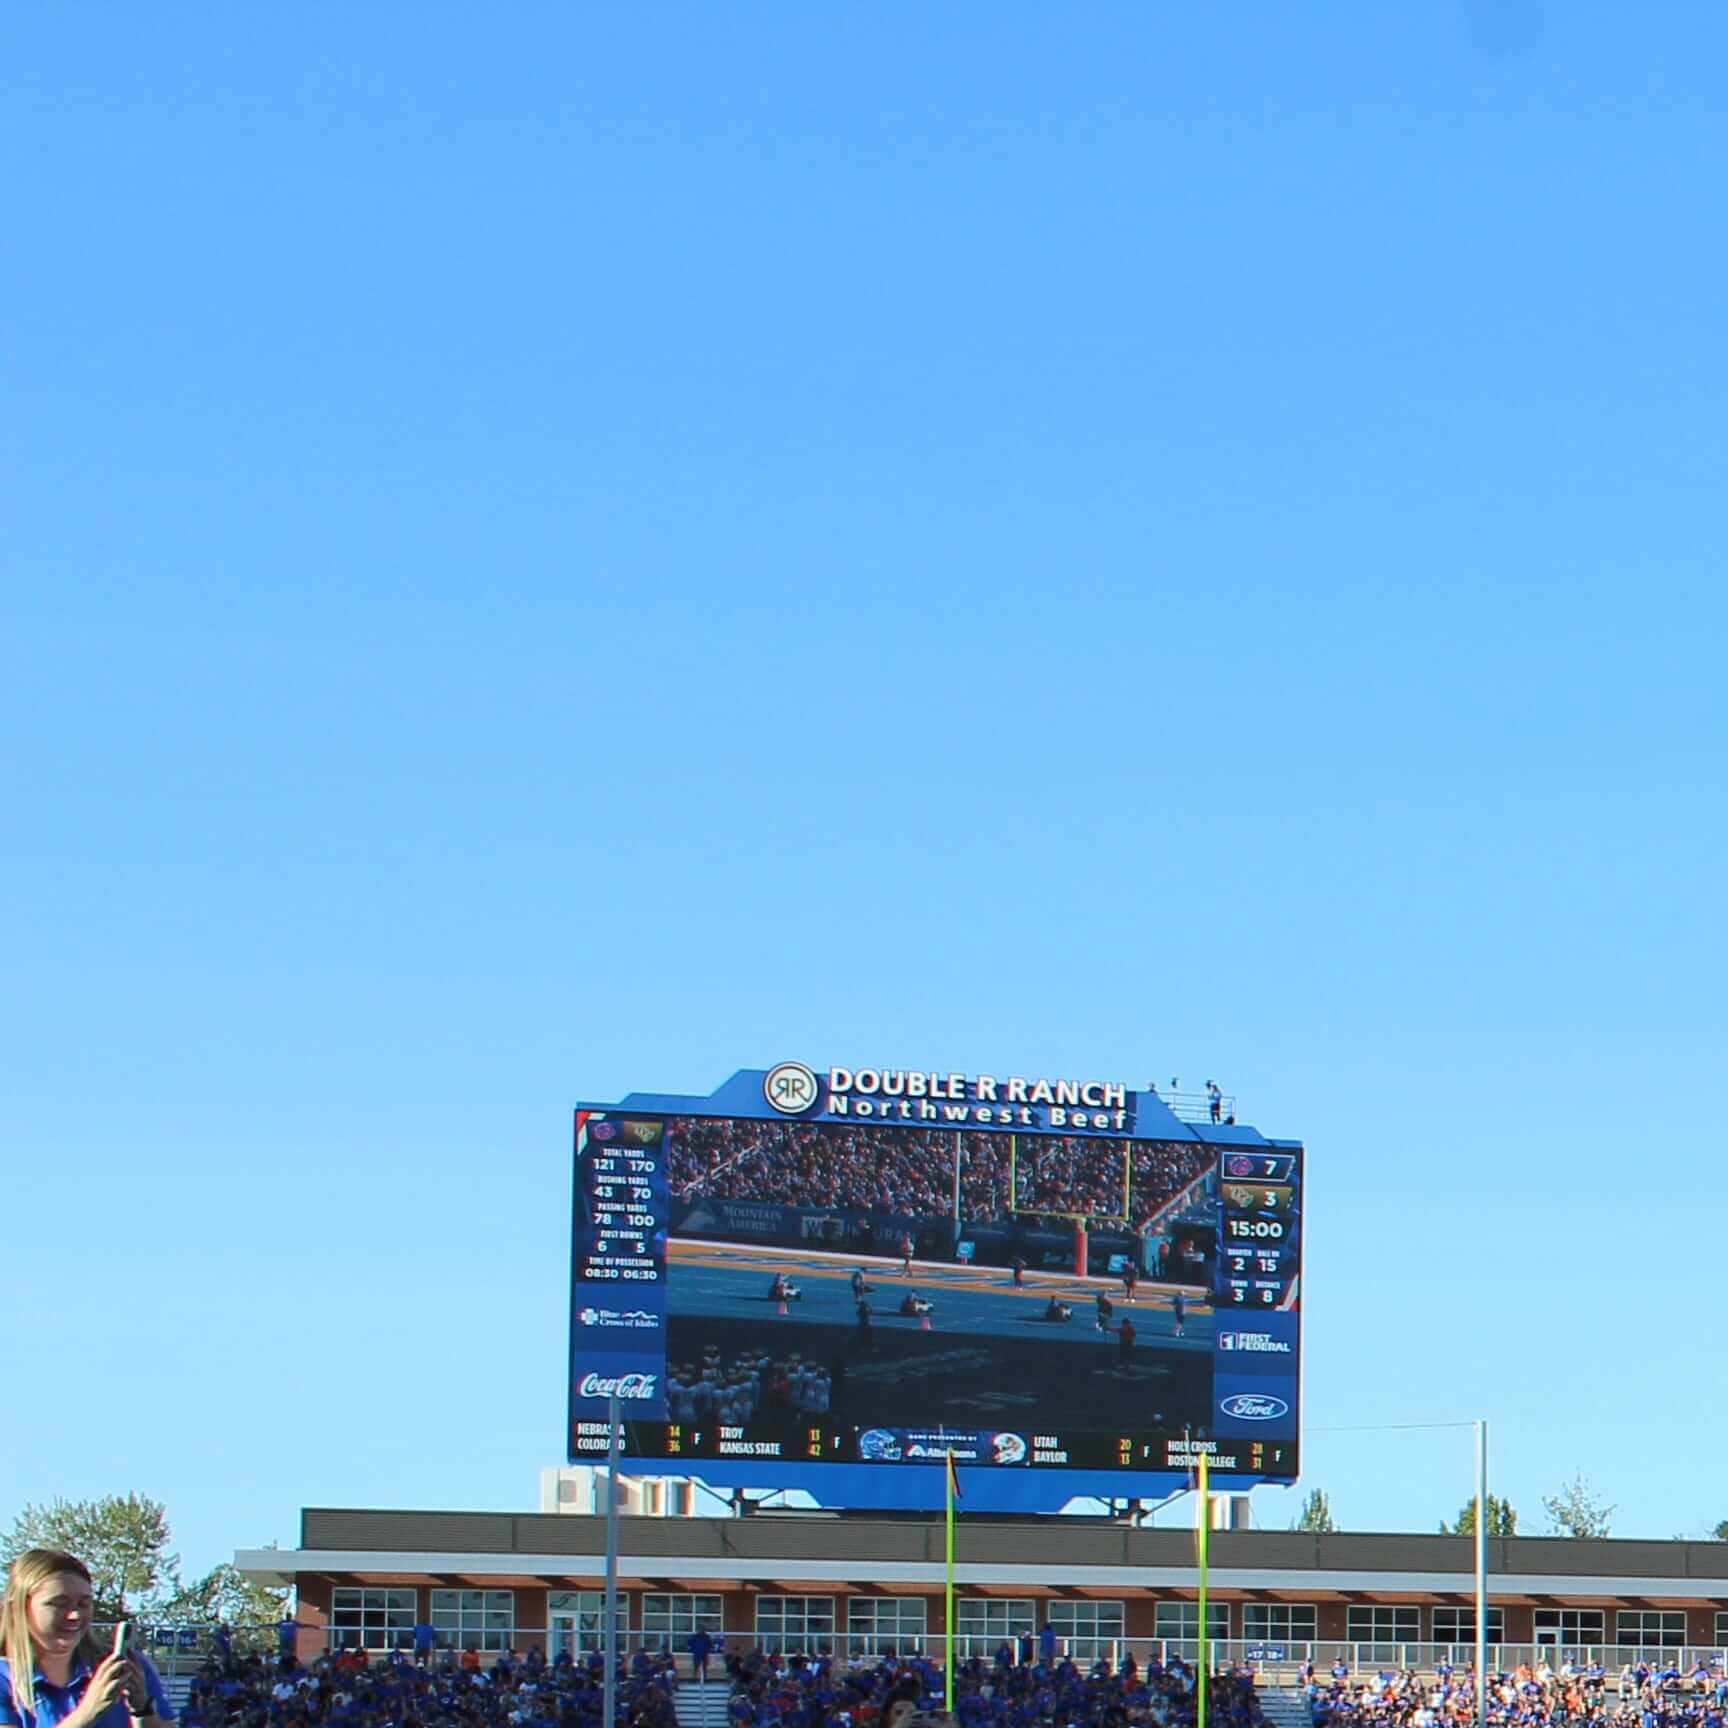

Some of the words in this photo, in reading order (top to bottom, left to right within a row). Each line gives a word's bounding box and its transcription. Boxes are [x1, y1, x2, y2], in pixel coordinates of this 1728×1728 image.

[829, 1066, 967, 1100] DOUBLE
[976, 1075, 997, 1101] R
[1007, 1077, 1126, 1109] RANCH
[829, 1095, 1033, 1126] Northwest
[1050, 1106, 1127, 1130] Beef
[593, 1158, 614, 1170] 121
[630, 1160, 655, 1173] 170
[1265, 1160, 1277, 1175] 7
[594, 1186, 613, 1198] 43
[632, 1187, 651, 1200] 70
[1265, 1191, 1277, 1207] 3
[594, 1213, 612, 1225] 78
[627, 1214, 655, 1227] 100
[1230, 1220, 1283, 1238] 15:00
[597, 1240, 607, 1252] 6
[636, 1242, 646, 1254] 5
[1233, 1257, 1245, 1271] 2
[1259, 1258, 1277, 1272] 15
[585, 1268, 619, 1279] 08:30
[623, 1269, 657, 1281] 06:30
[1233, 1288, 1244, 1302] 3
[1262, 1290, 1273, 1303] 8
[1239, 1332, 1272, 1342] FIRST
[1239, 1342, 1291, 1352] FEDERAL
[1233, 1397, 1275, 1415] Ford
[720, 1426, 744, 1440] TROY
[720, 1440, 755, 1454] KANSAS
[756, 1442, 781, 1456] STATE
[1034, 1436, 1058, 1448] UTAH
[1191, 1441, 1217, 1453] CROSS
[1034, 1451, 1067, 1464] BAYLOR
[1202, 1456, 1237, 1469] OLLEGE
